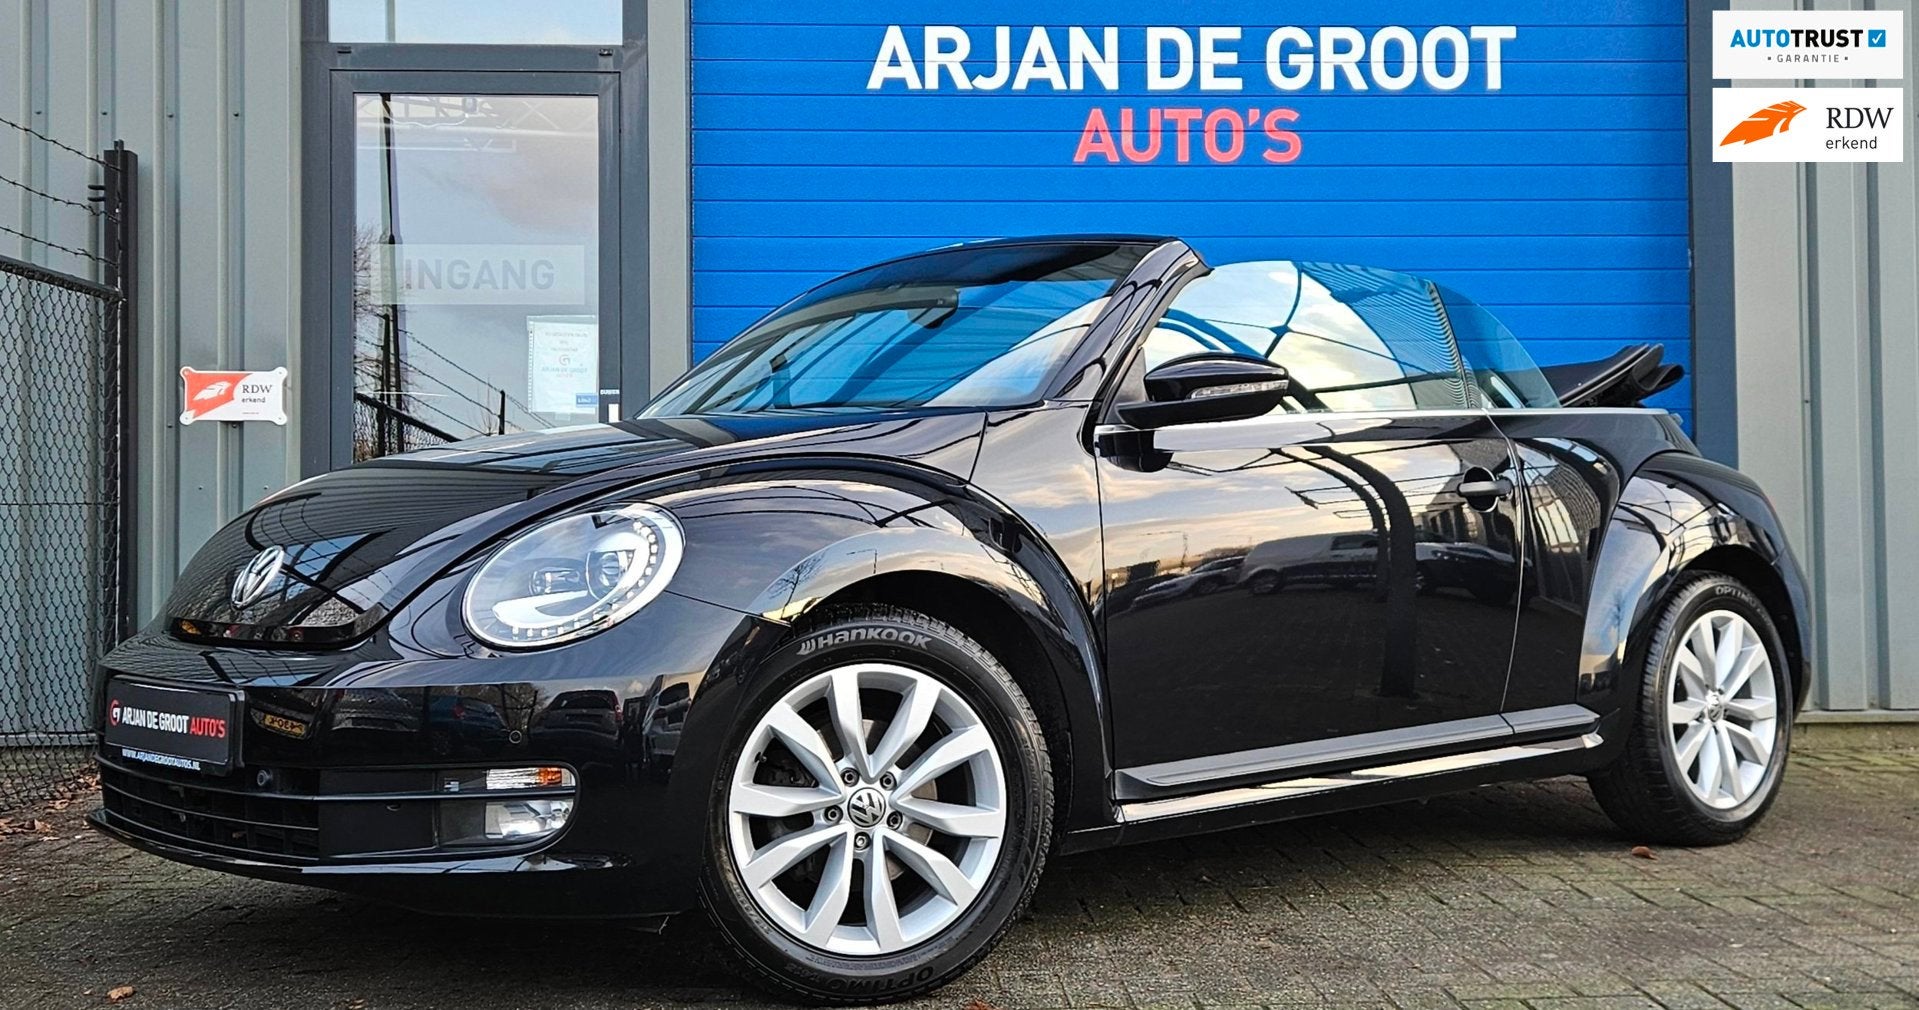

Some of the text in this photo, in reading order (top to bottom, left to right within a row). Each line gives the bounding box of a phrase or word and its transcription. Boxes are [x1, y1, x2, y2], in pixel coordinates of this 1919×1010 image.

[866, 25, 1517, 90] ARJAN DE GROOT
[1073, 107, 1303, 163] AUTO'S
[405, 258, 555, 290] INGANG
[241, 384, 273, 394] RDW
[121, 706, 226, 739] ARJAN DE GROOT AUTO'S
